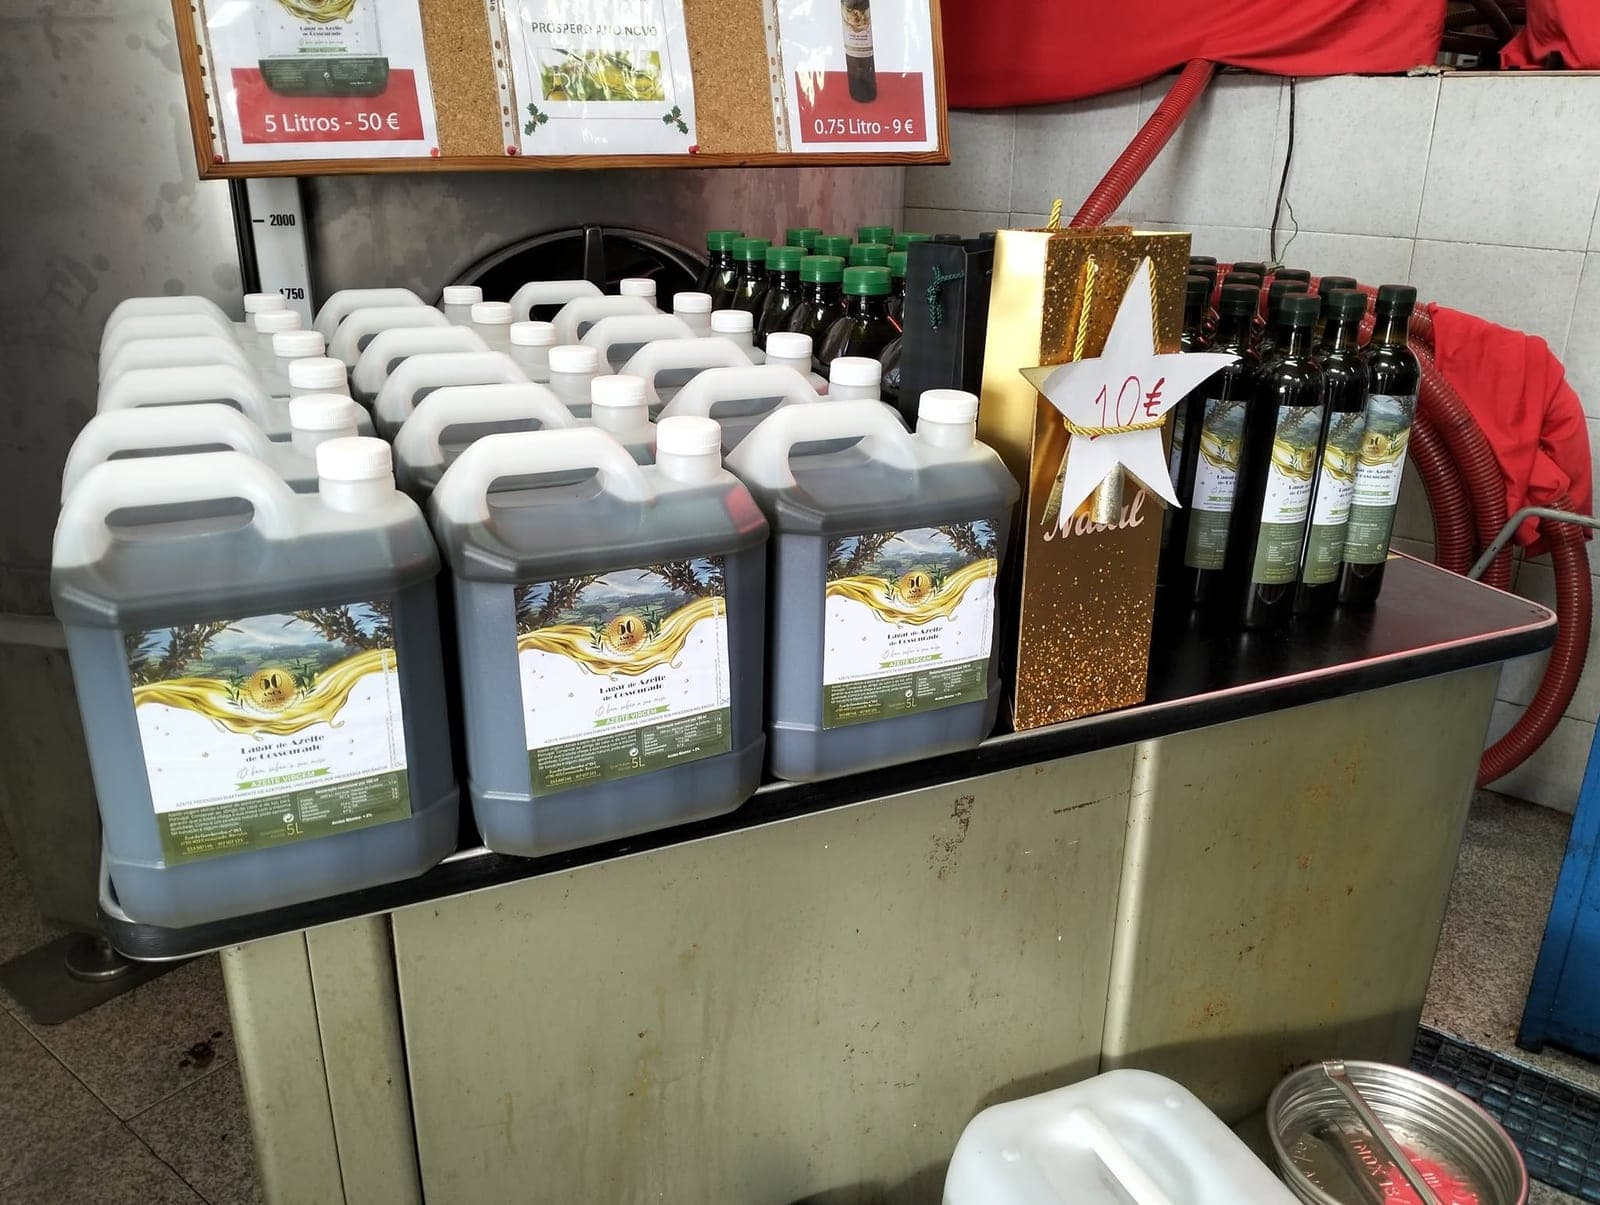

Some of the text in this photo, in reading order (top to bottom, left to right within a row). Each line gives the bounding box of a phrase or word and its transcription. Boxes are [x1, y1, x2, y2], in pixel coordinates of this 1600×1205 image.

[625, 25, 657, 37] NOVO
[264, 114, 277, 132] 5
[282, 113, 340, 132] Litros
[357, 113, 382, 131] 50
[386, 112, 400, 130] €
[814, 119, 845, 134] 0.75
[849, 119, 881, 134] Litro
[893, 119, 902, 134] 9
[905, 119, 914, 134] €
[269, 214, 296, 226] 2000
[1043, 490, 1146, 542] Naal
[617, 619, 635, 635] 50
[889, 655, 933, 667] AZEITE VIRGEM
[258, 673, 283, 690] 50
[599, 684, 625, 694] Lagar
[639, 674, 667, 685] Azeite
[905, 699, 918, 709] 5L
[606, 708, 657, 725] AZEITE VIRGEM
[240, 734, 325, 755] Lagar de Azeite
[245, 744, 322, 763] de Cossourado
[631, 756, 646, 769] 5L
[251, 770, 315, 788] AZEITE VIRGEM
[286, 822, 303, 837] 5L
